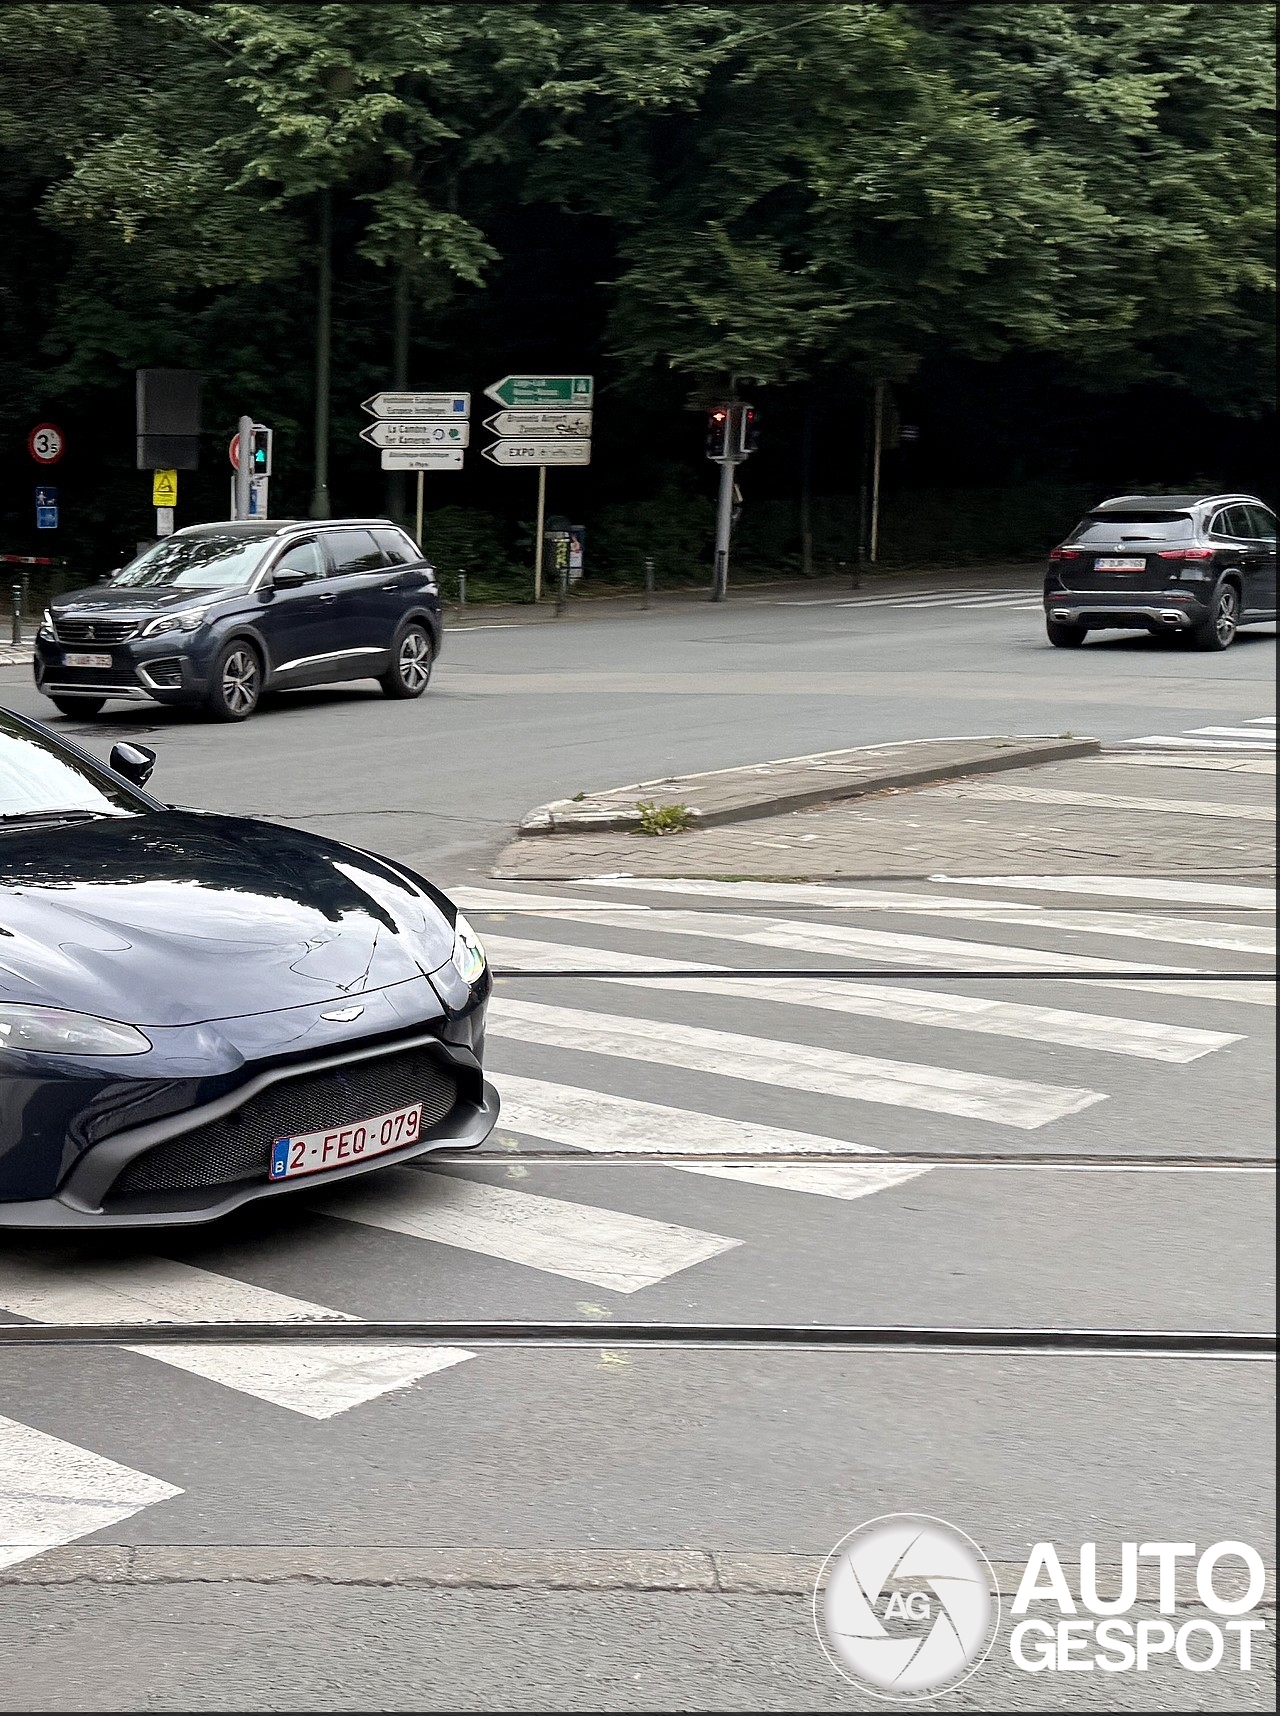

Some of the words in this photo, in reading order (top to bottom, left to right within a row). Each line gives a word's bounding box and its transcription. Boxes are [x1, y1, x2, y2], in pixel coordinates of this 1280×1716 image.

[508, 447, 536, 457] EXPO
[274, 1160, 285, 1174] B
[289, 1110, 418, 1170] 2-FEQ-079
